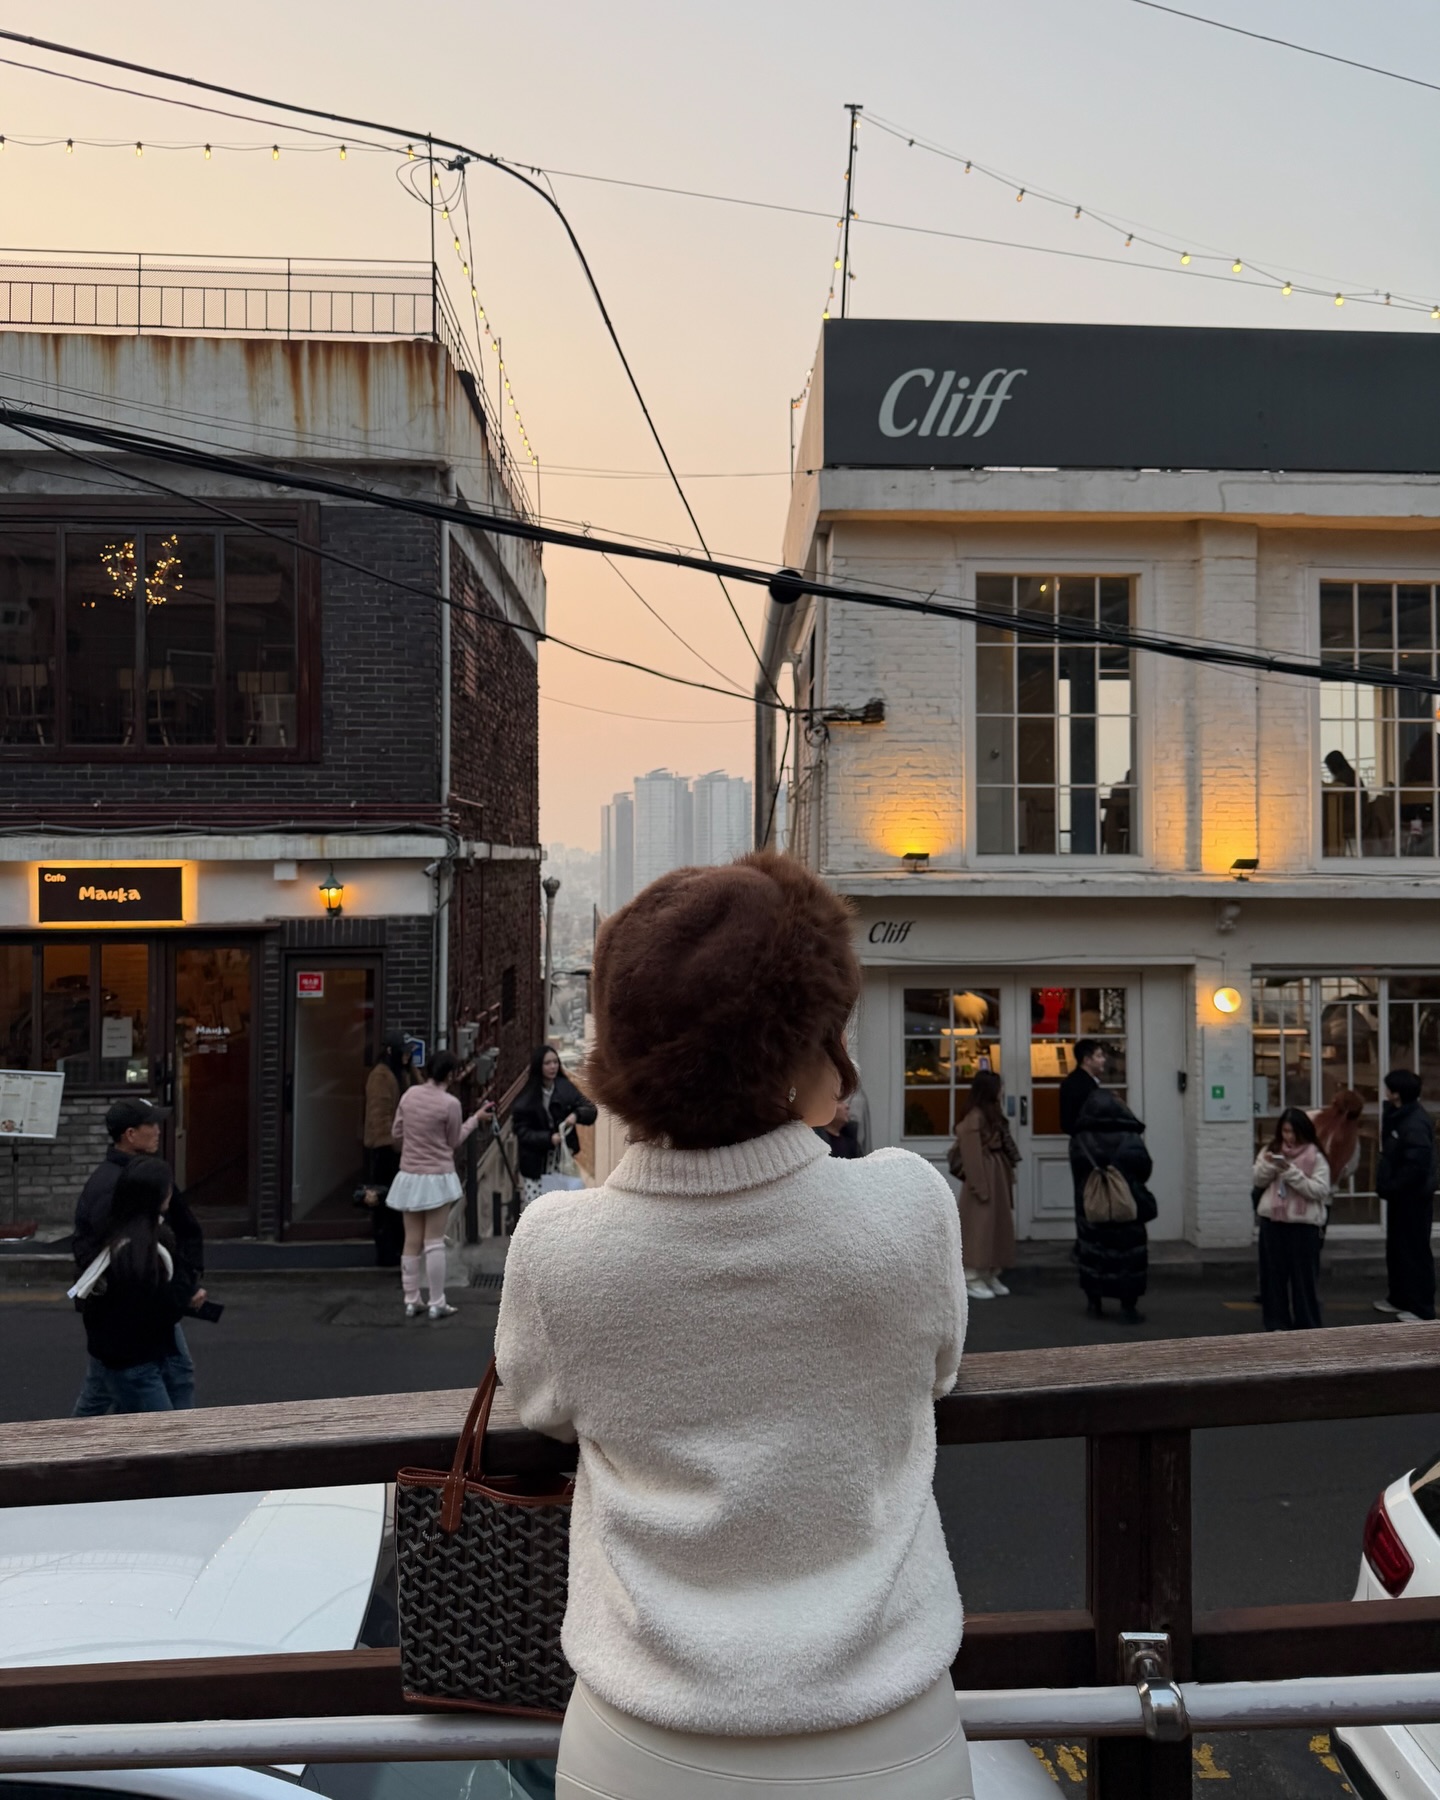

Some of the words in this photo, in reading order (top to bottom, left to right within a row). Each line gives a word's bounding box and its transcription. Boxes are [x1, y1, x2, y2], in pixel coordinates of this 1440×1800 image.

[878, 367, 1028, 438] Cliff
[44, 873, 66, 882] Cafe
[79, 887, 141, 903] Mauka
[869, 920, 917, 943] Cliff
